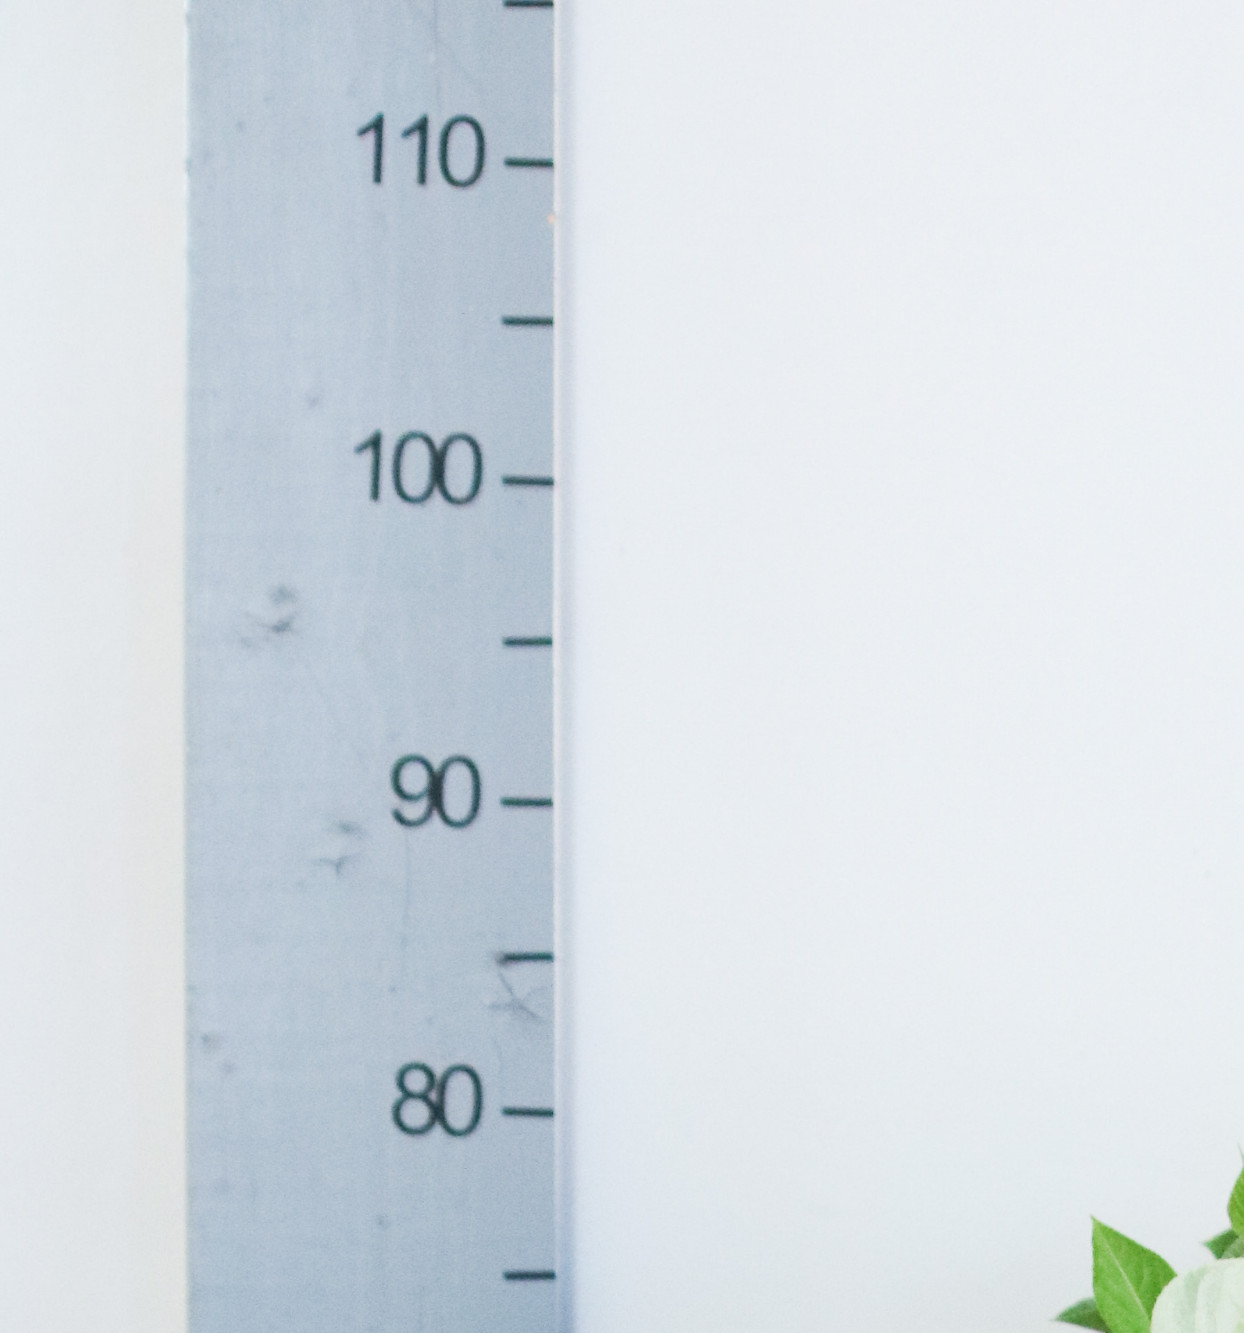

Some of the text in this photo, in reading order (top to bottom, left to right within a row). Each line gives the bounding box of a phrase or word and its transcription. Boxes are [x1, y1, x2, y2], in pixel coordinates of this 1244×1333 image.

[356, 112, 487, 188] 110
[355, 430, 484, 505] 100
[391, 754, 482, 829] 90
[392, 1062, 484, 1137] 80
